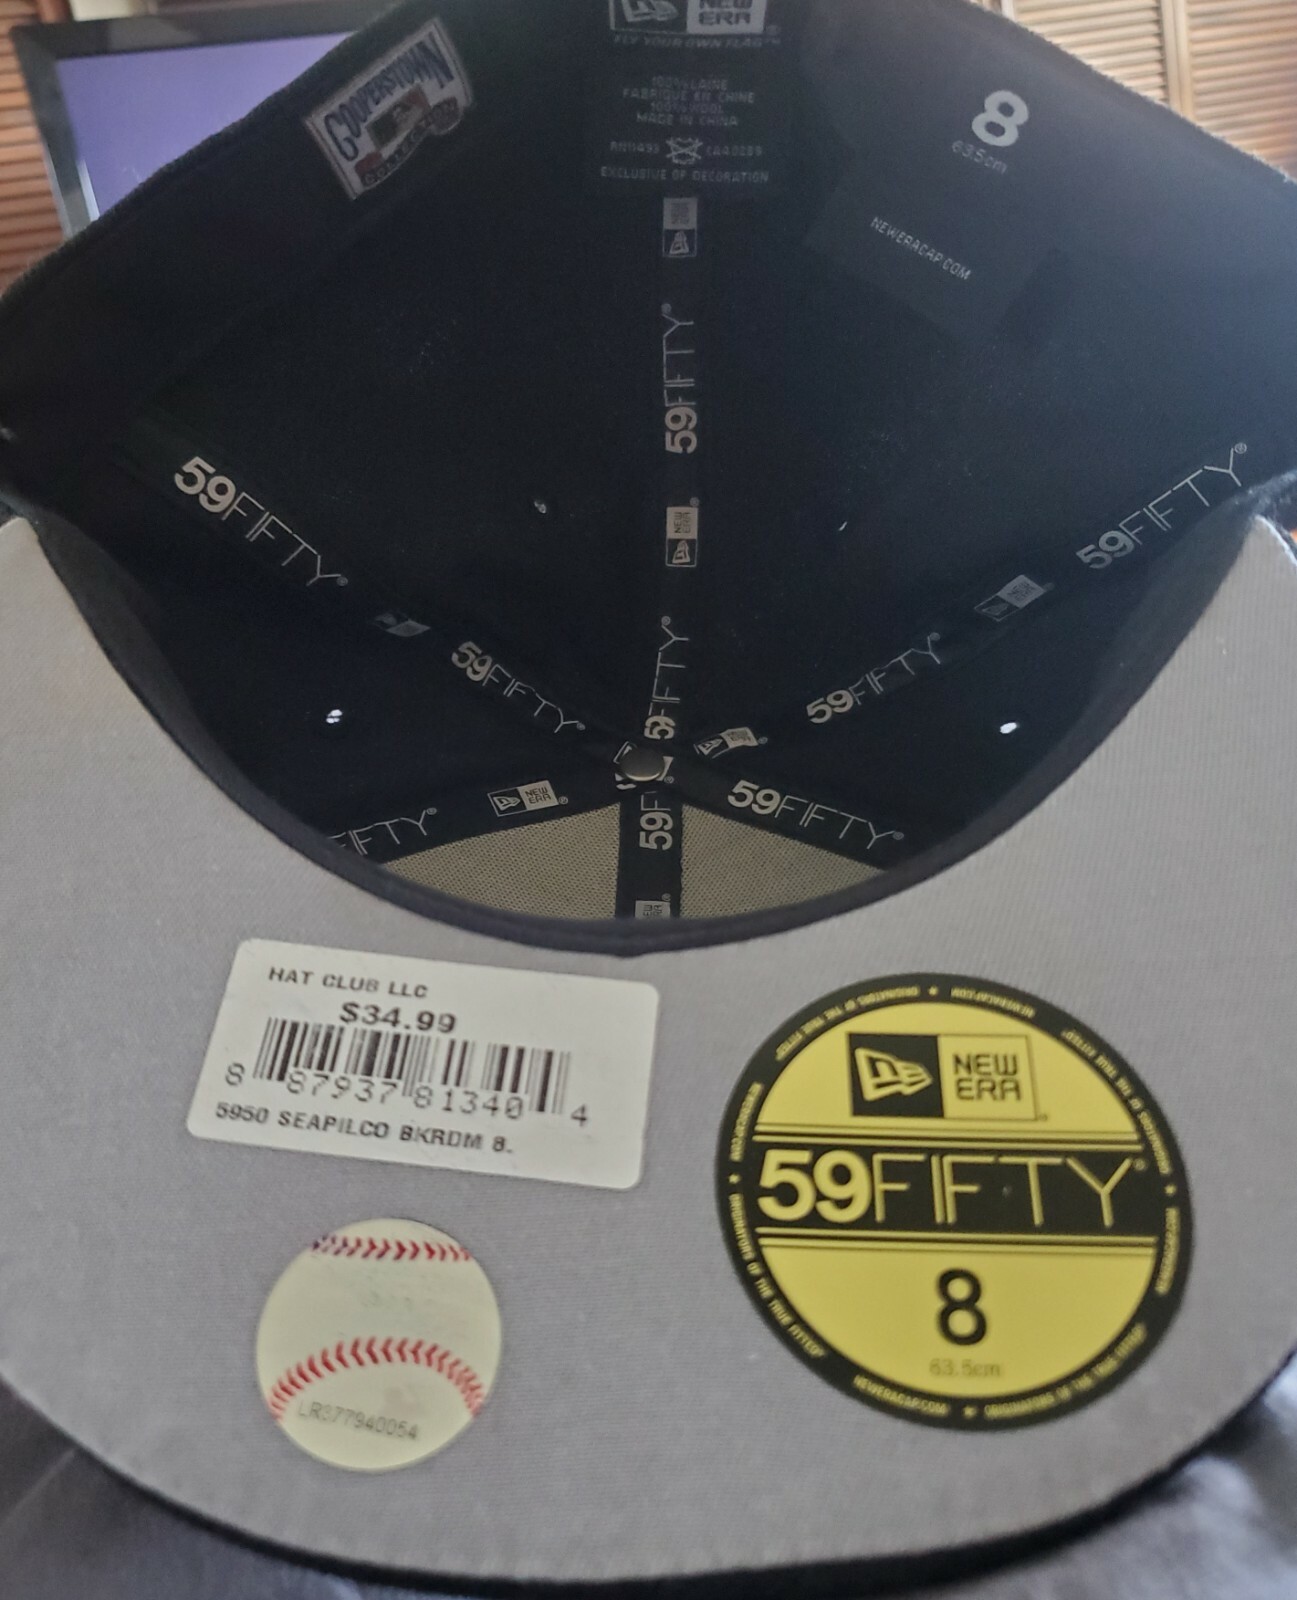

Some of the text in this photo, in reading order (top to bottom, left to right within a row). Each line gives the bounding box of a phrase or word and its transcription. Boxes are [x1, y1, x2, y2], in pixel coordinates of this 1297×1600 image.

[698, 12, 751, 25] ERA
[699, 115, 738, 127] CHINA
[971, 89, 1029, 147] 8
[601, 166, 769, 183] EXCLUSIVE OF DECORATION
[525, 786, 548, 798] NEW
[528, 793, 552, 804] ERA
[268, 966, 429, 1000] HAT CLUB LLC
[340, 1001, 457, 1034] $34.99
[953, 1053, 1020, 1077] NEW
[225, 1061, 590, 1128] 8 87937 81340 4
[956, 1079, 1021, 1102] ERA
[215, 1101, 269, 1125] 5950
[278, 1110, 389, 1140] SEAPILCO
[399, 1124, 483, 1151] BKRDM
[757, 1149, 1133, 1228] 59FIFTY
[935, 1268, 988, 1346] 8
